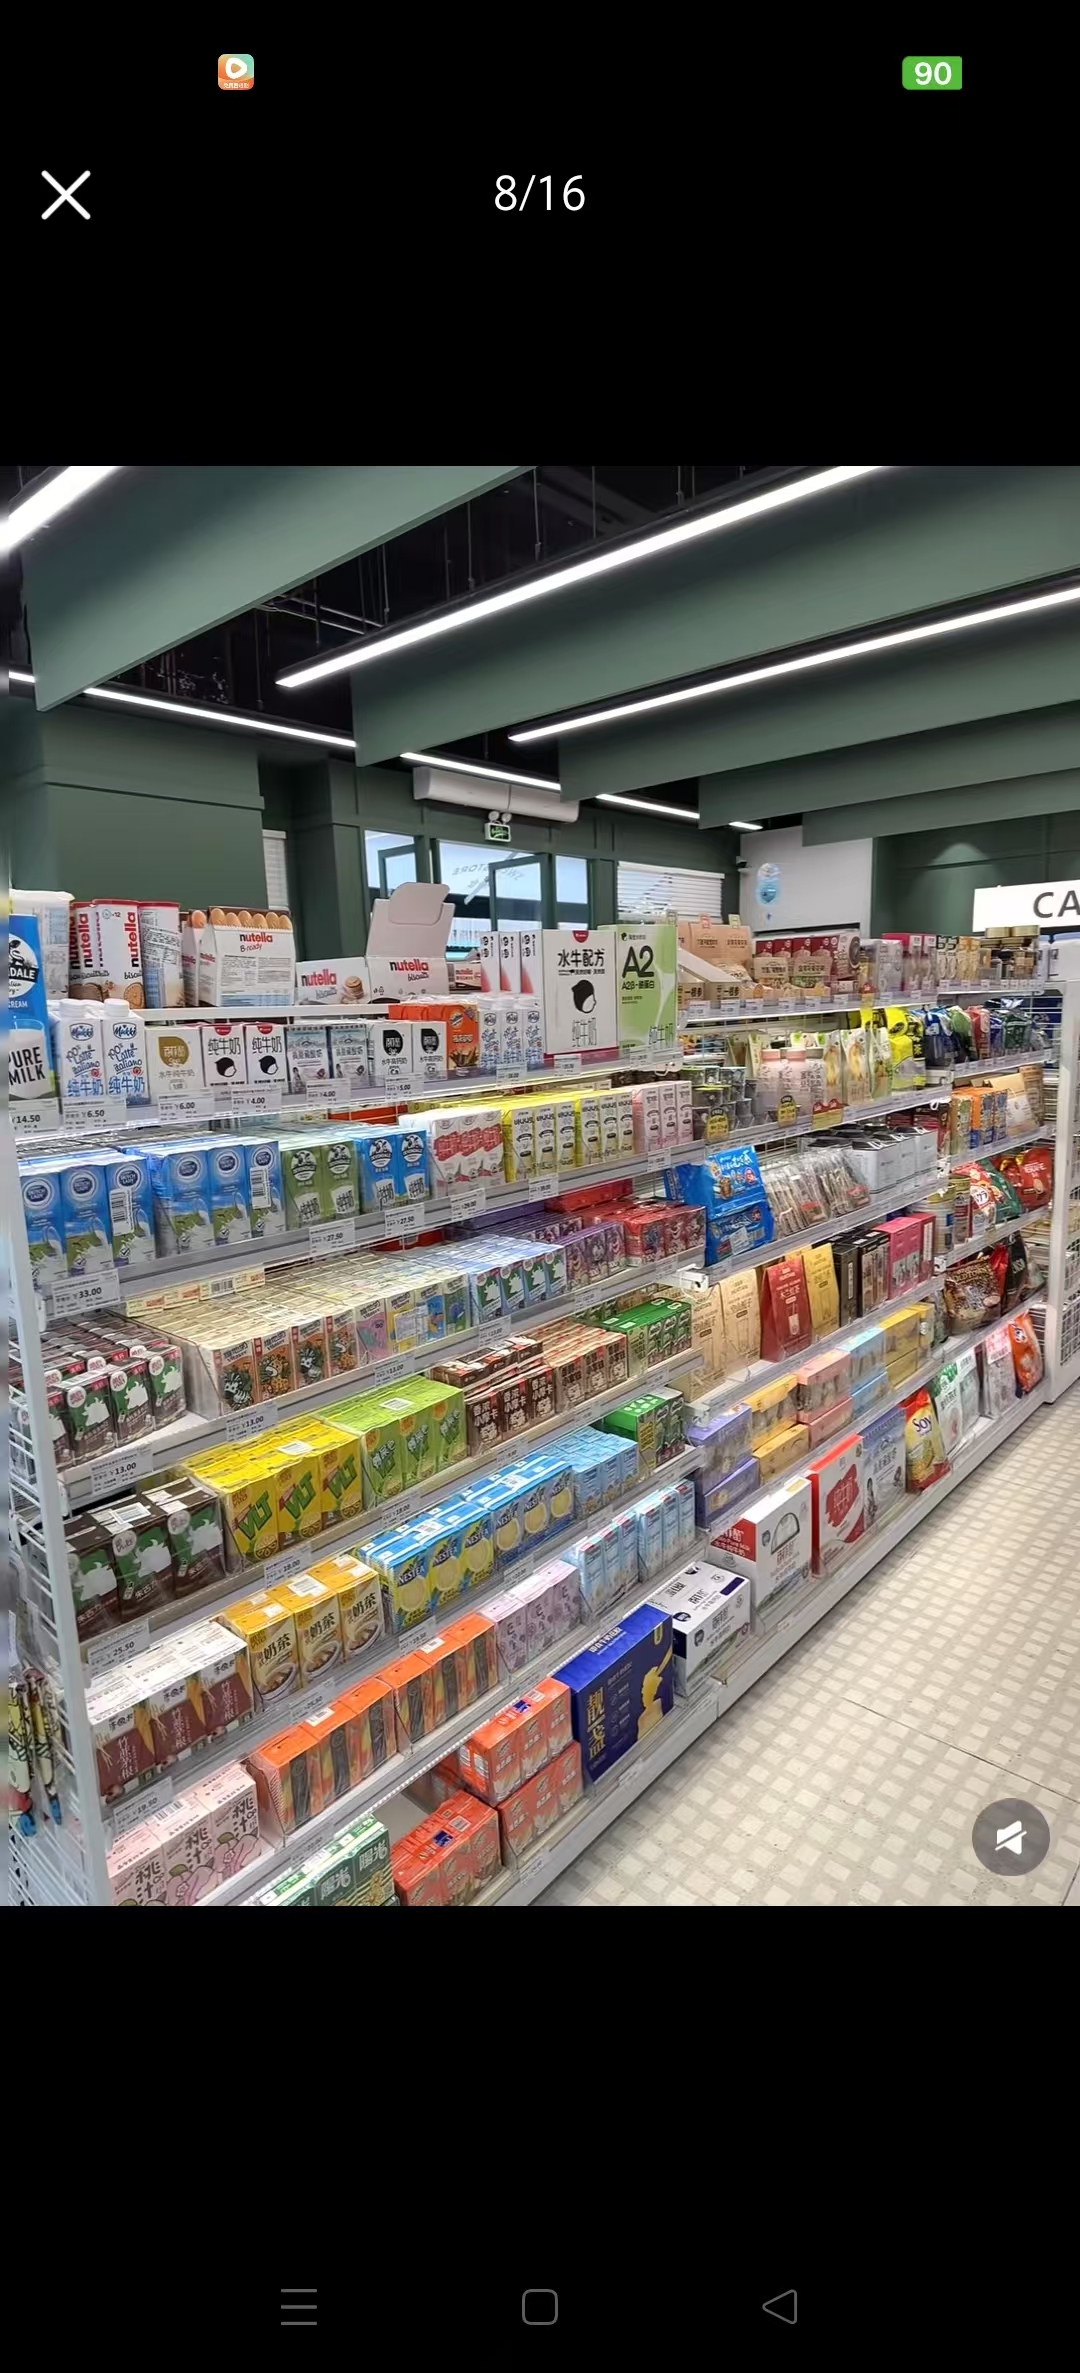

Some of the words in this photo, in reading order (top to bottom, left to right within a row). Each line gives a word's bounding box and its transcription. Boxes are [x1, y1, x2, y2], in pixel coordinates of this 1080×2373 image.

[78, 913, 93, 968] nutella
[124, 911, 140, 968] nutella
[239, 932, 273, 944] nutella
[389, 958, 429, 972] nutella
[557, 948, 605, 968] 水牛配方
[622, 944, 655, 979] A2
[301, 969, 337, 987] nutella
[207, 1037, 241, 1055] 纯牛奶
[252, 1035, 283, 1055] 纯牛奶
[67, 1079, 104, 1097] 纯牛奶
[108, 1075, 146, 1096] 纯牛奶
[466, 1527, 490, 1547] NESTEA
[432, 1546, 458, 1566] NESTEA
[398, 1565, 426, 1585] NESTEA
[352, 1592, 377, 1618] 奶茶
[309, 1611, 336, 1639] 奶茶
[263, 1632, 291, 1660] 奶茶
[359, 1839, 388, 1872] 陽光
[320, 1866, 352, 1900] 陽光
